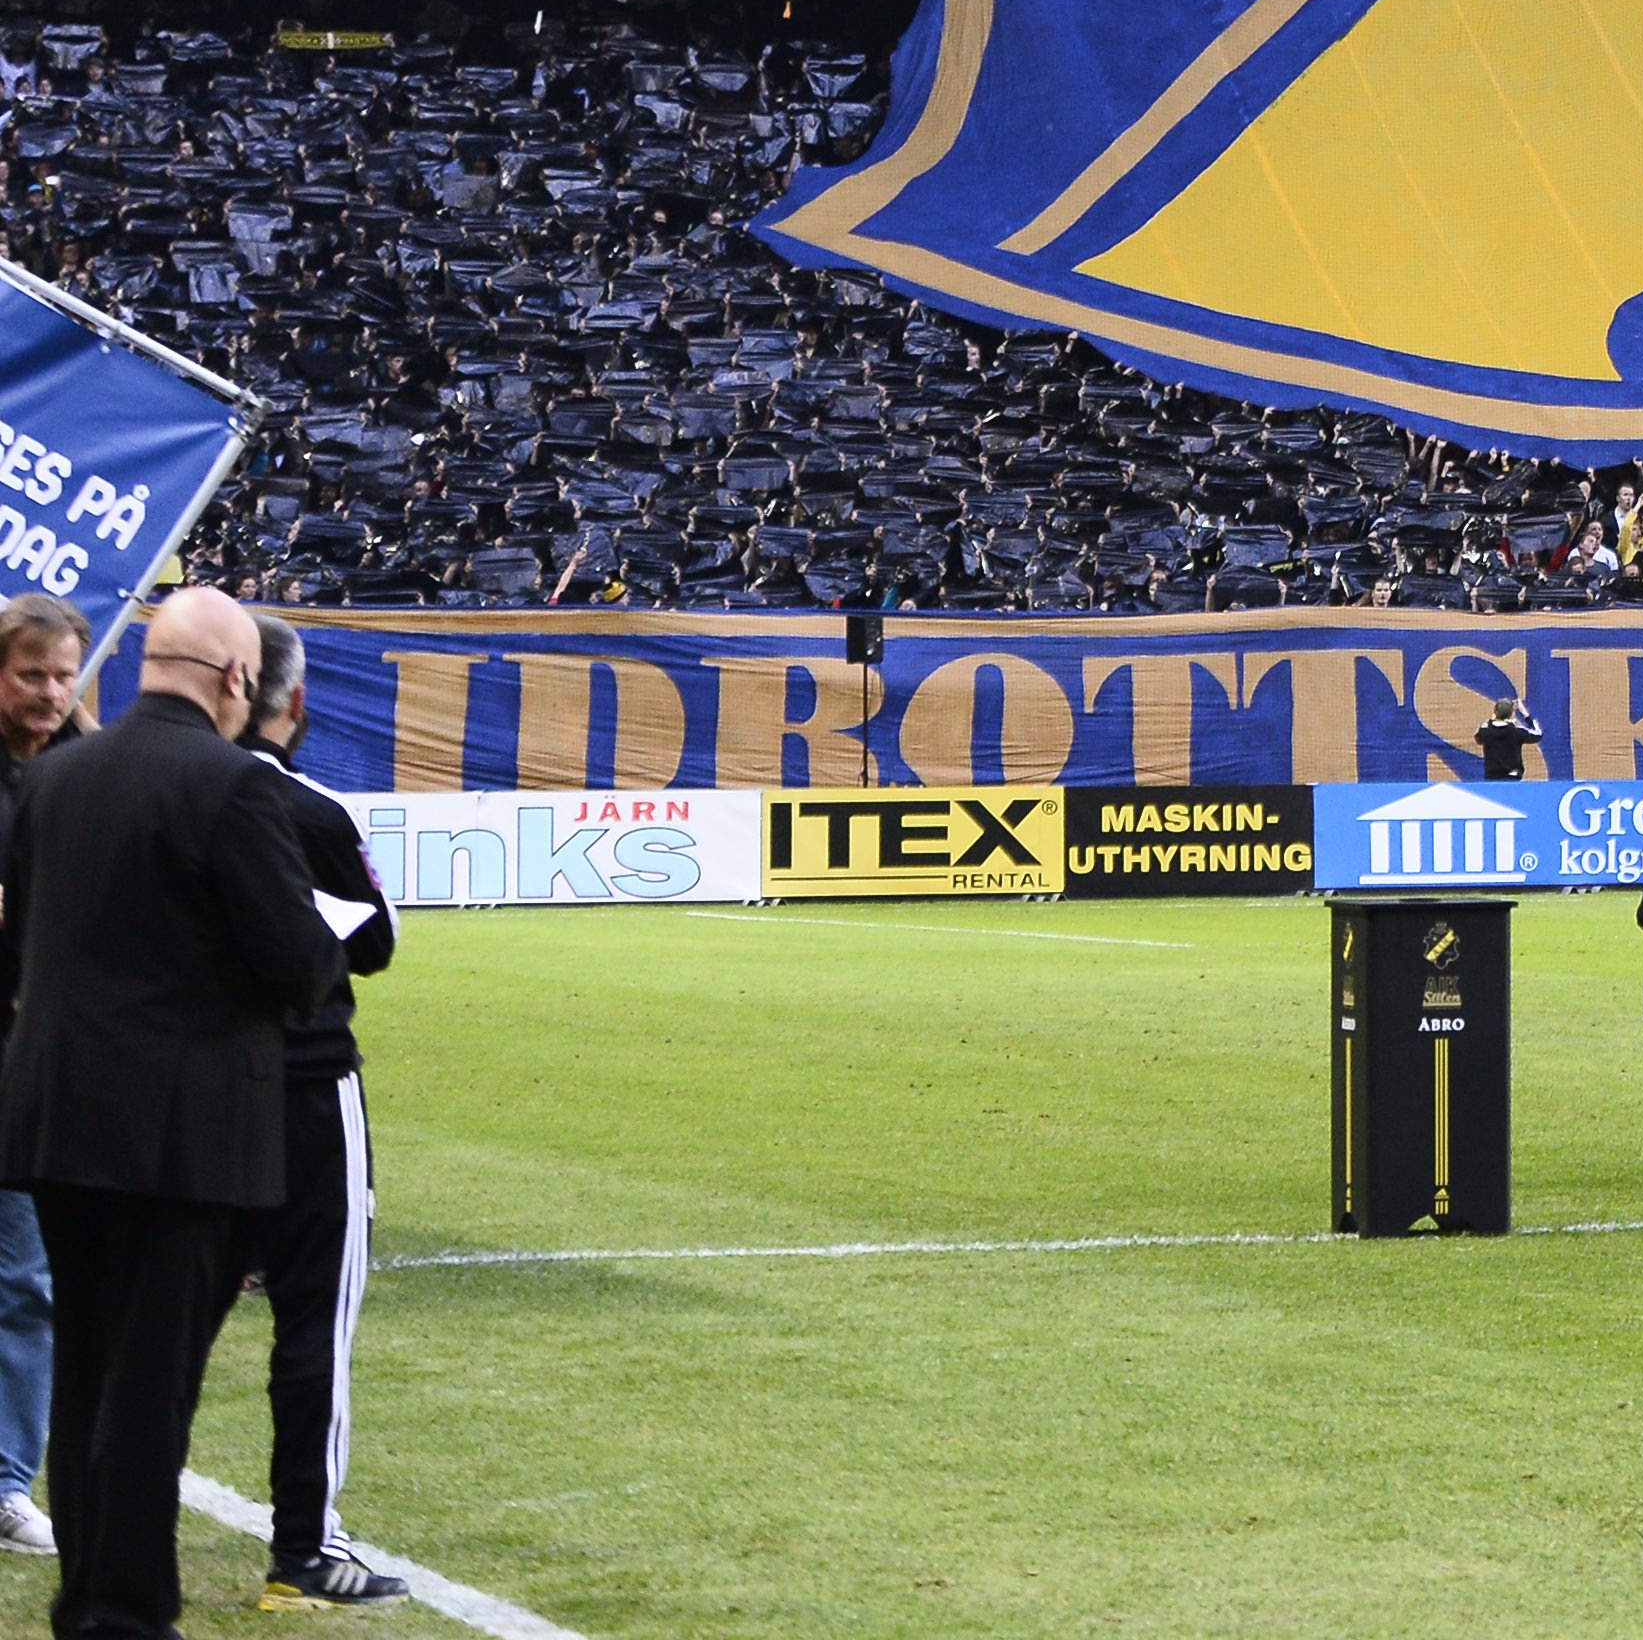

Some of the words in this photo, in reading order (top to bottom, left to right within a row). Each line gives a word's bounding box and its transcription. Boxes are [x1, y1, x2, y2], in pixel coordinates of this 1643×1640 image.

[66, 475, 150, 550] PÅ
[573, 794, 691, 823] JÄRN
[1100, 804, 1279, 833] MASKIN-
[769, 798, 1042, 871] ITEX
[1068, 844, 1312, 874] UTHYRNING
[952, 872, 1050, 890] RENTAL
